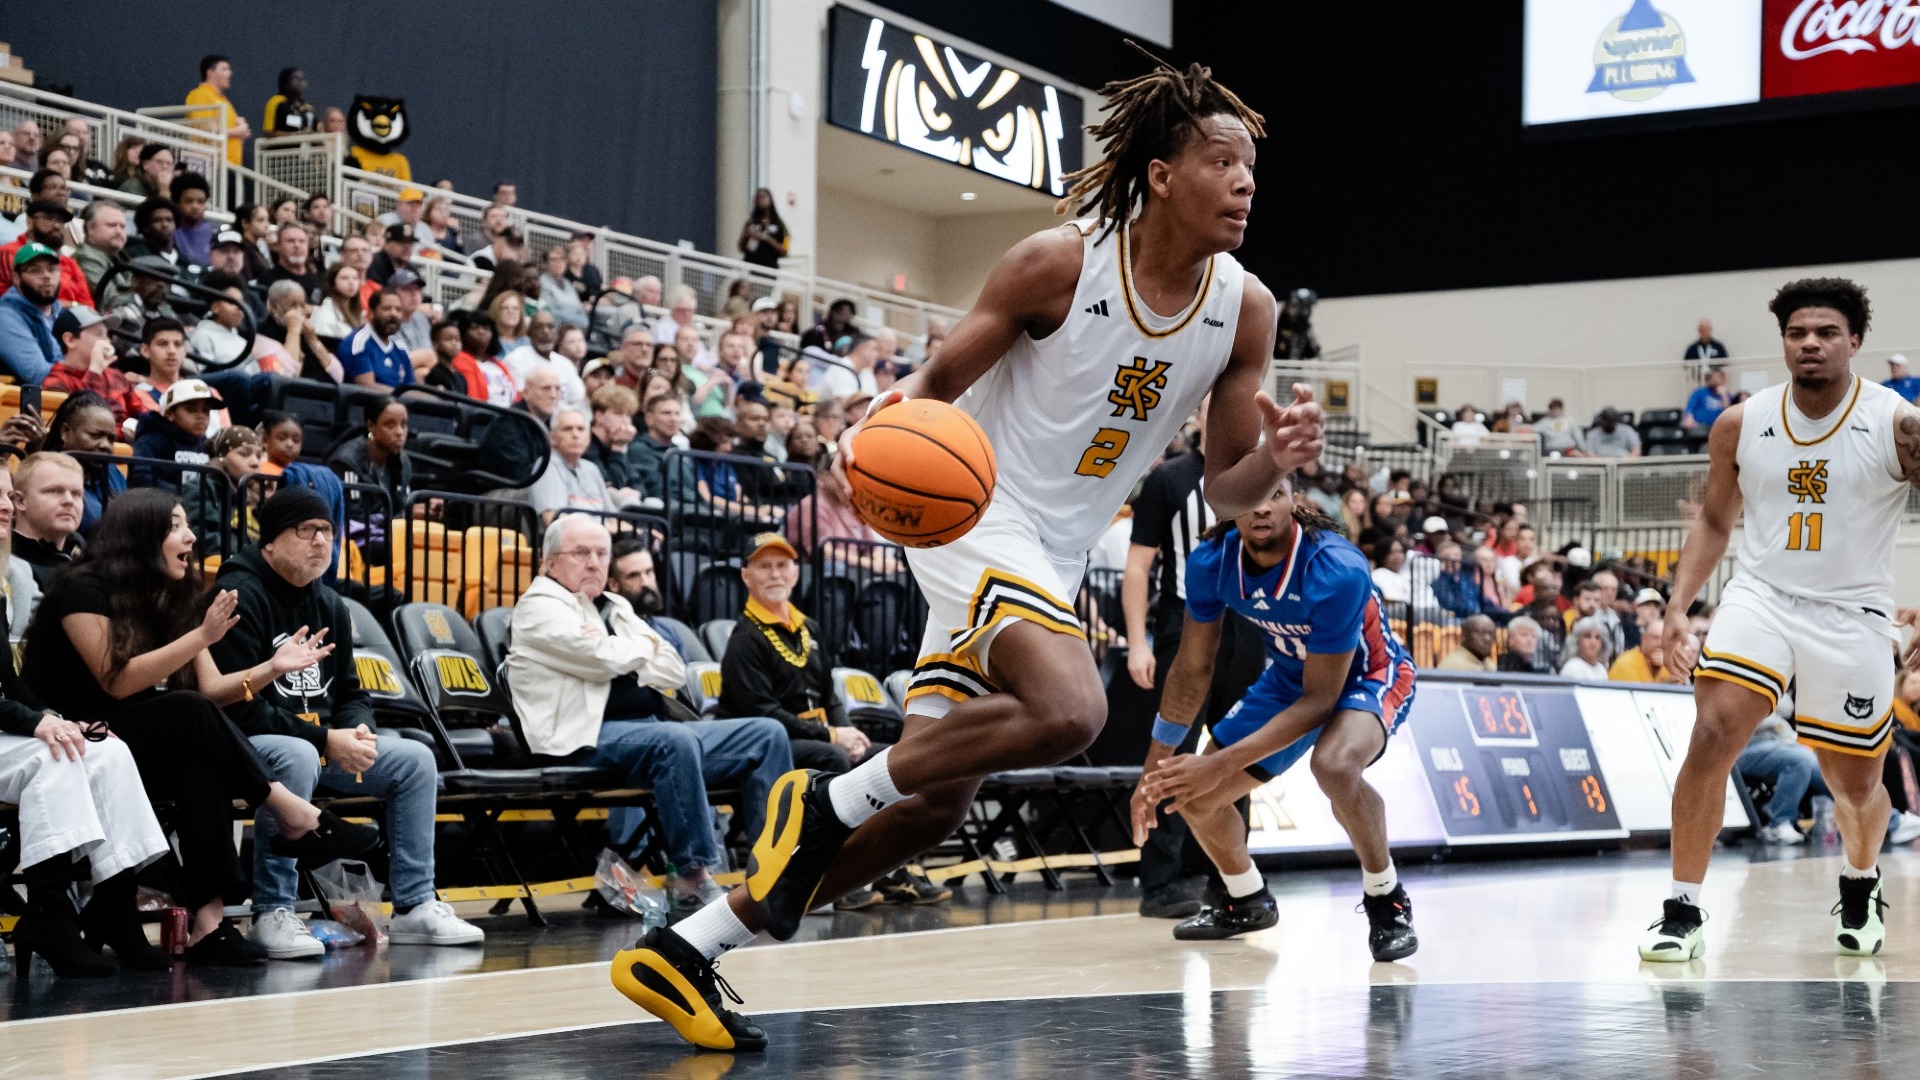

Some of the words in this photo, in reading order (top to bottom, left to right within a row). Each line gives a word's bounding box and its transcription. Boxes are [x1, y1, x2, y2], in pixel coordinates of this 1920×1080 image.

[1074, 427, 1130, 478] 2
[1785, 512, 1823, 551] 11
[353, 656, 401, 694] WLS
[436, 656, 488, 691] OWLS
[1453, 776, 1481, 816] 15
[1522, 784, 1538, 816] 1
[1580, 774, 1607, 813] 13
